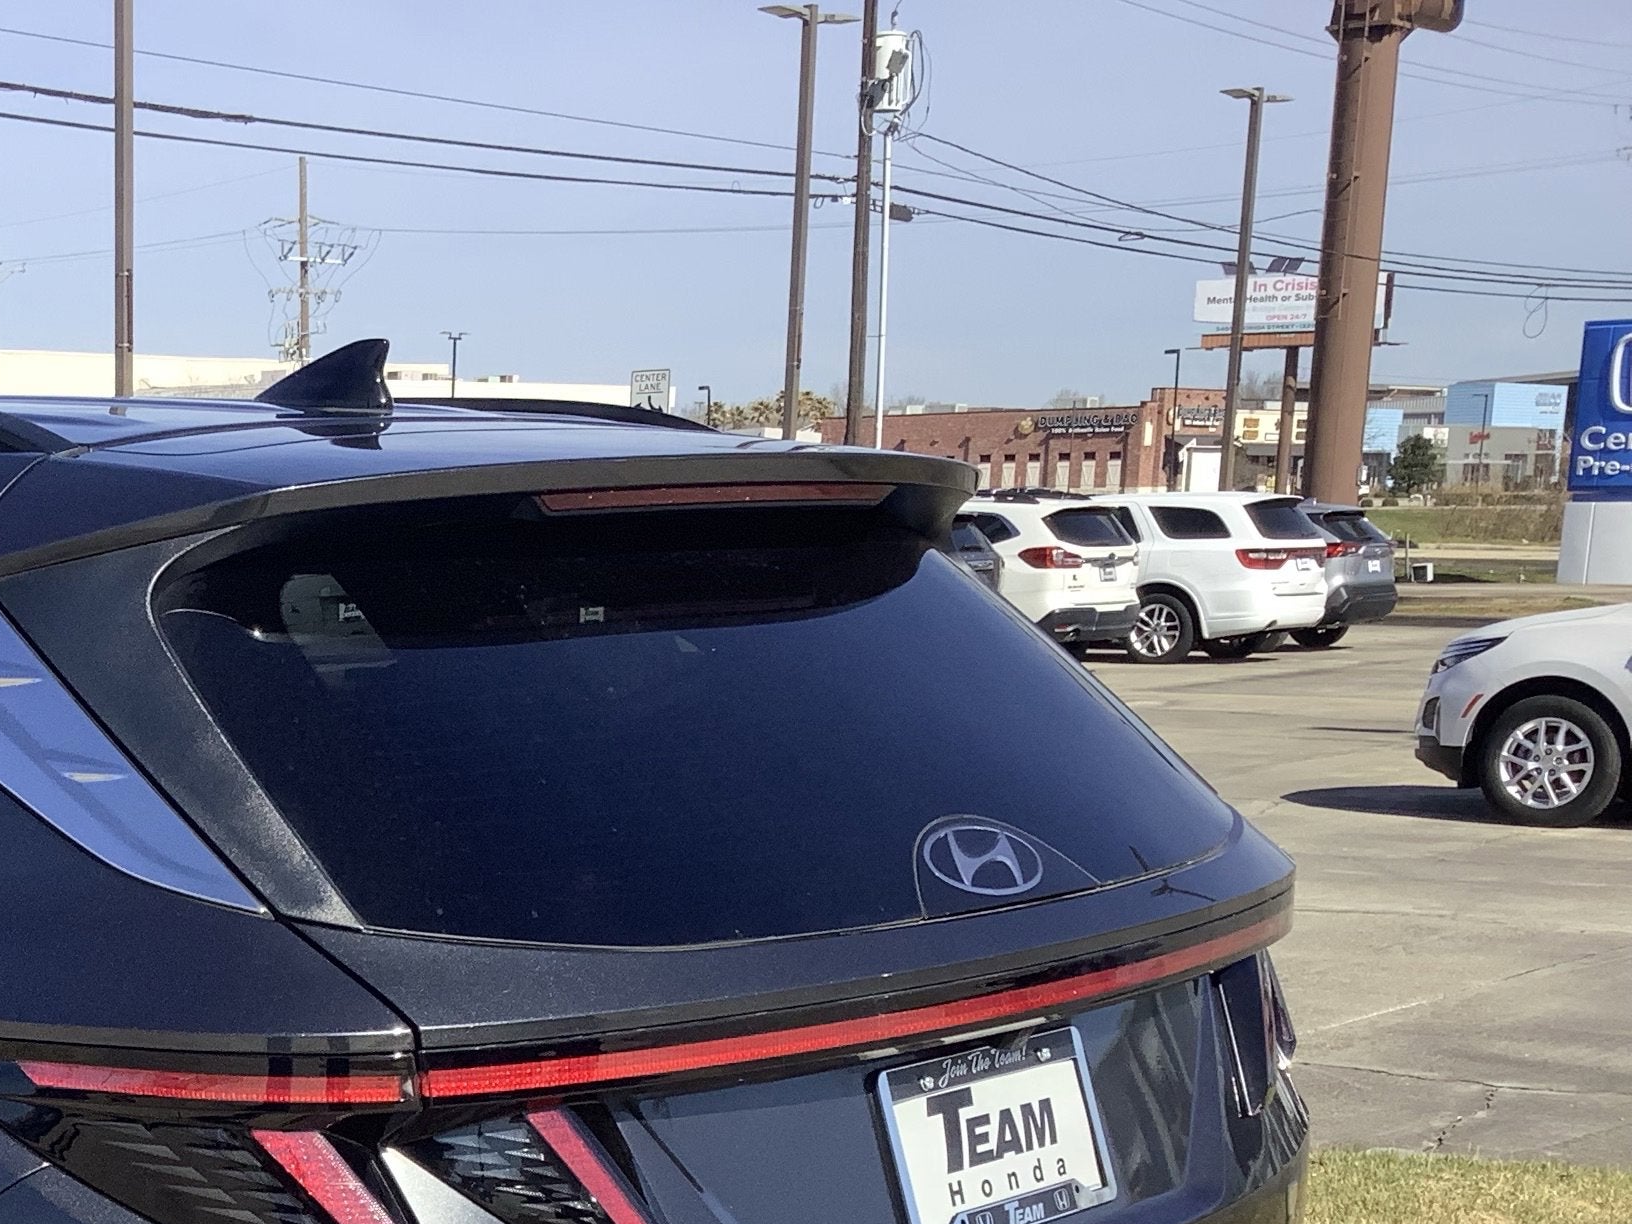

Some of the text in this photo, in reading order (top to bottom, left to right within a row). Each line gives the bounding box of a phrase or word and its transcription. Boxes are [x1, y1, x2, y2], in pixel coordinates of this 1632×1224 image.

[1253, 278, 1319, 292] In Crisis
[1206, 297, 1235, 305] Ment
[1294, 293, 1317, 302] Sub
[634, 372, 667, 383] CENTER
[638, 382, 662, 391] LANE
[1038, 415, 1099, 428] DUMPLING
[1101, 415, 1111, 425] &
[1576, 455, 1632, 476] Pre-
[938, 1044, 1026, 1088] Join The Team!
[926, 1086, 1058, 1174] TEAM
[948, 1157, 1067, 1207] Honda
